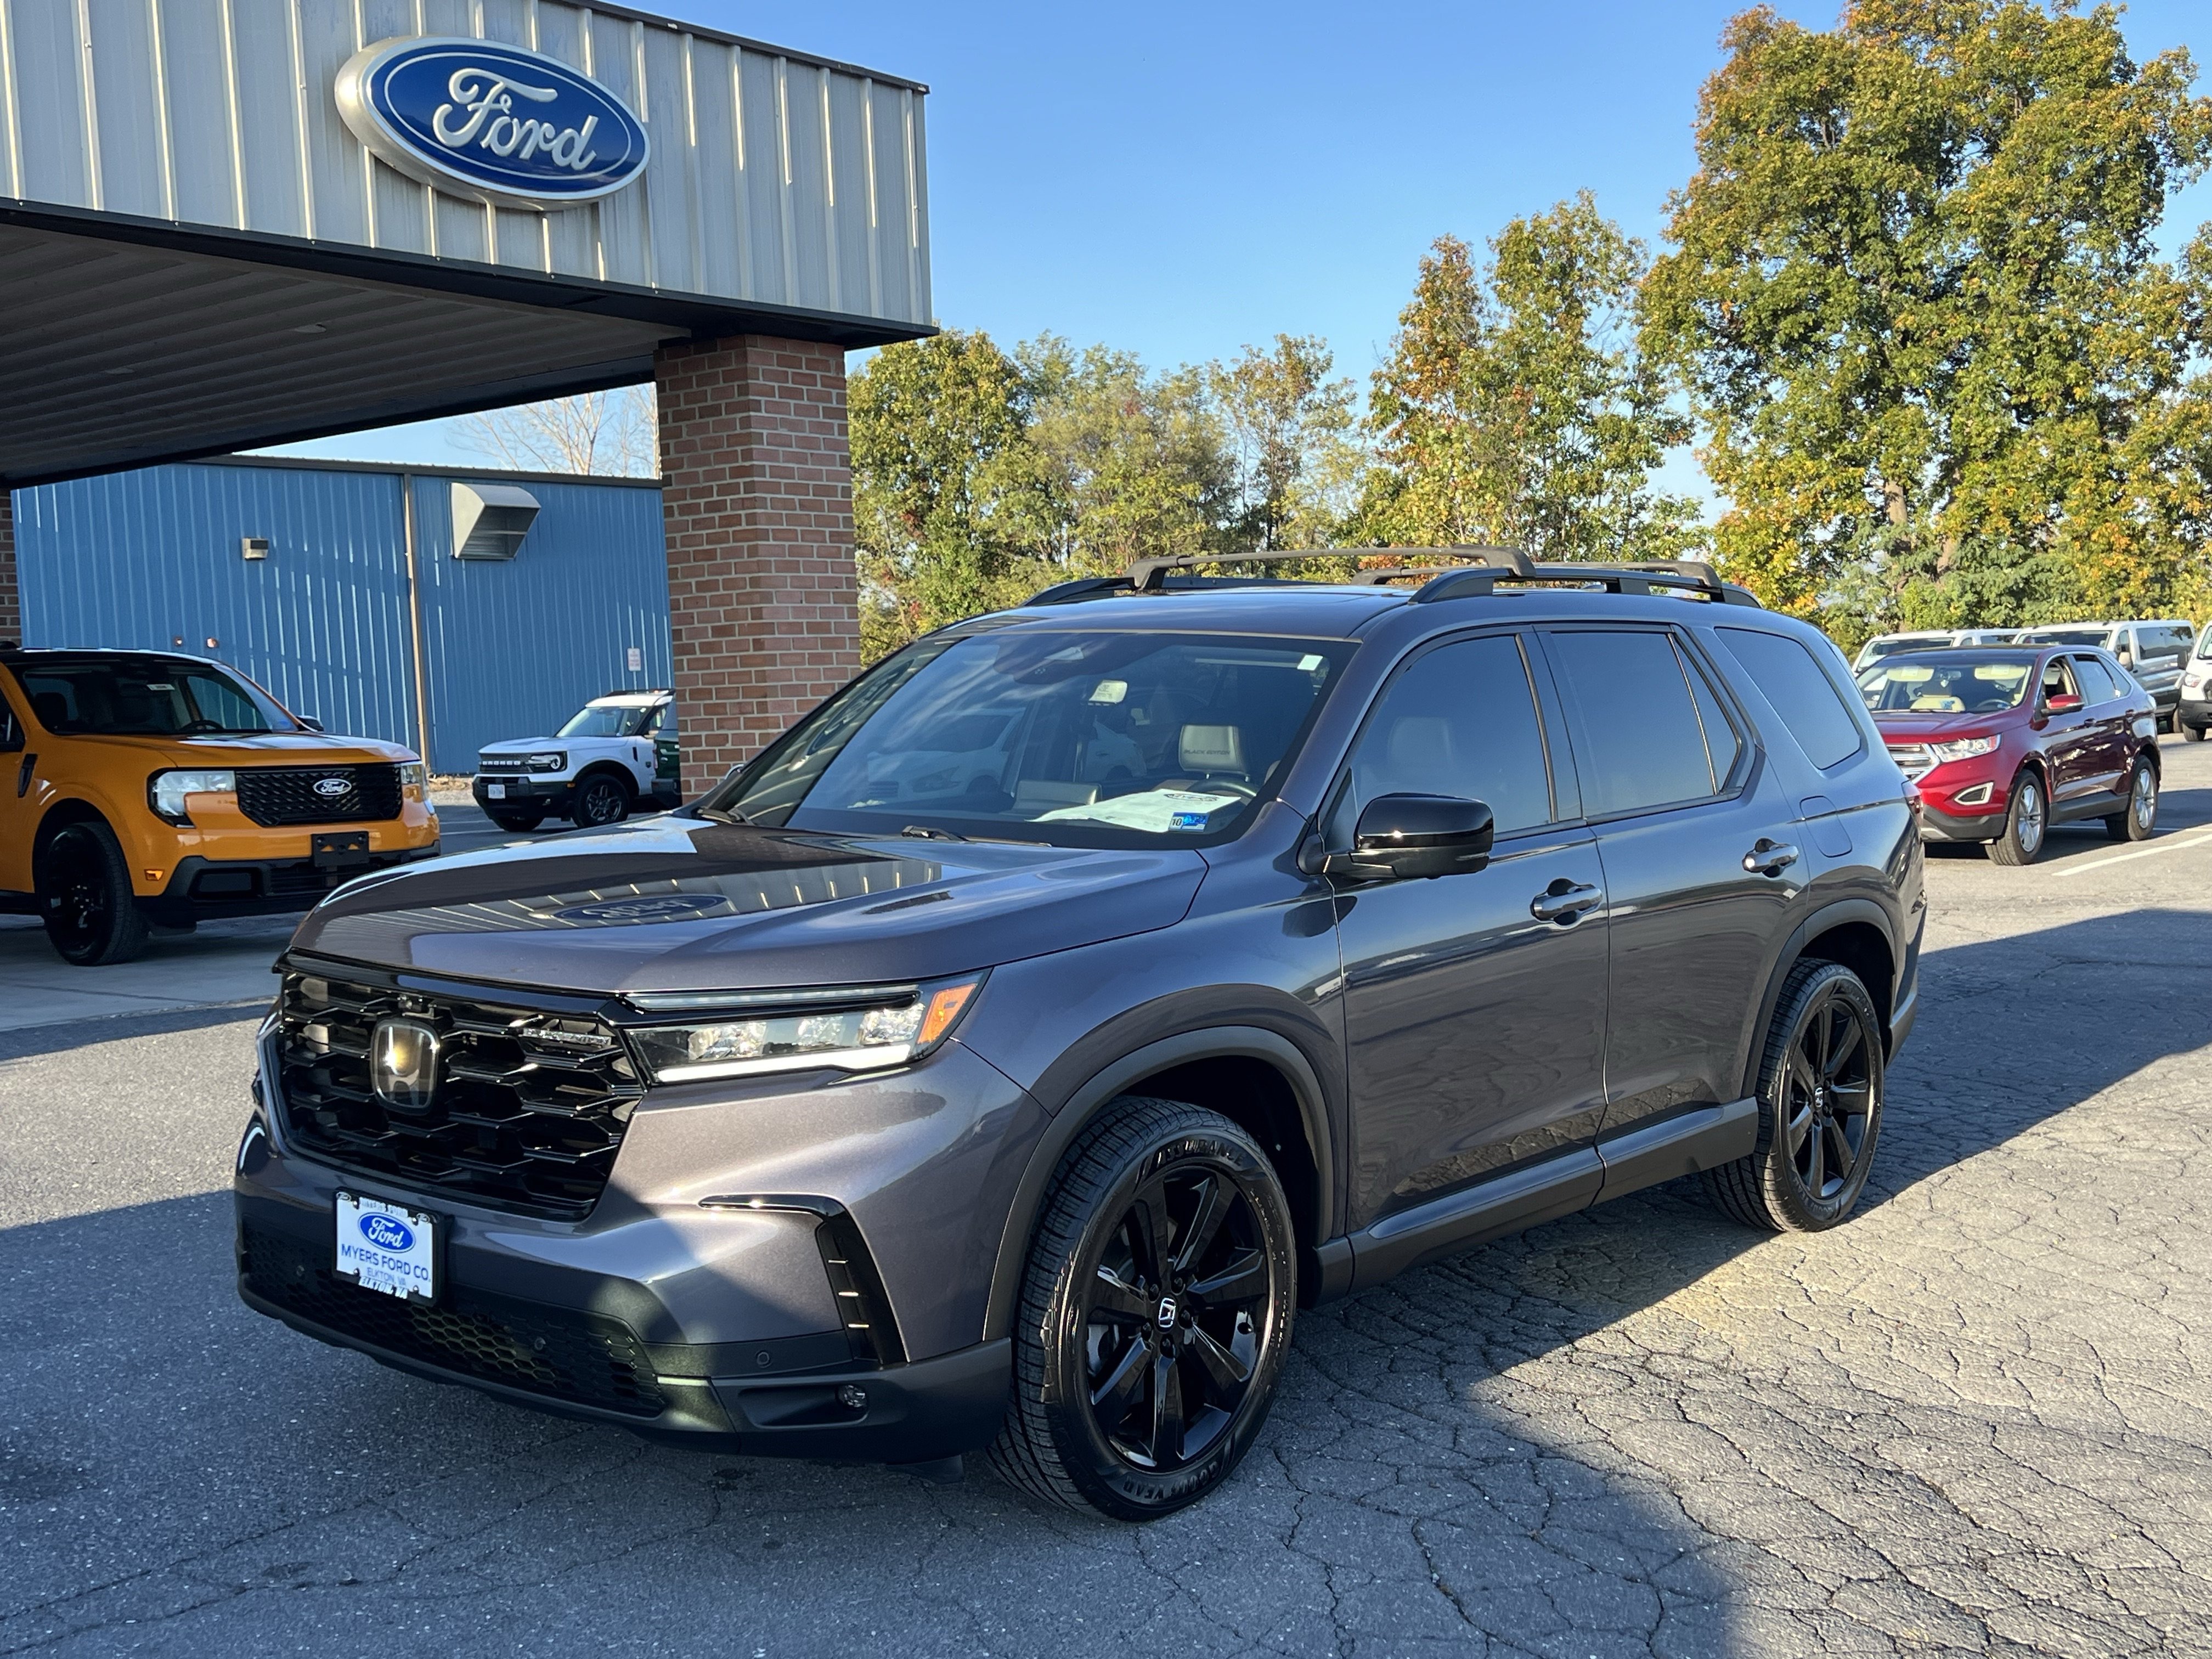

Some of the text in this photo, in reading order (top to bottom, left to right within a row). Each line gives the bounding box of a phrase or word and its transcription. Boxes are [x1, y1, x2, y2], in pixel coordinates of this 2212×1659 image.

[433, 67, 599, 171] Ford
[320, 781, 346, 793] Ford
[1172, 818, 1182, 826] 10
[1156, 1139, 1245, 1168] ASSURANCE
[368, 1217, 404, 1248] Ford
[341, 1243, 431, 1282] MYERS FORD CO.
[397, 1277, 407, 1286] VA
